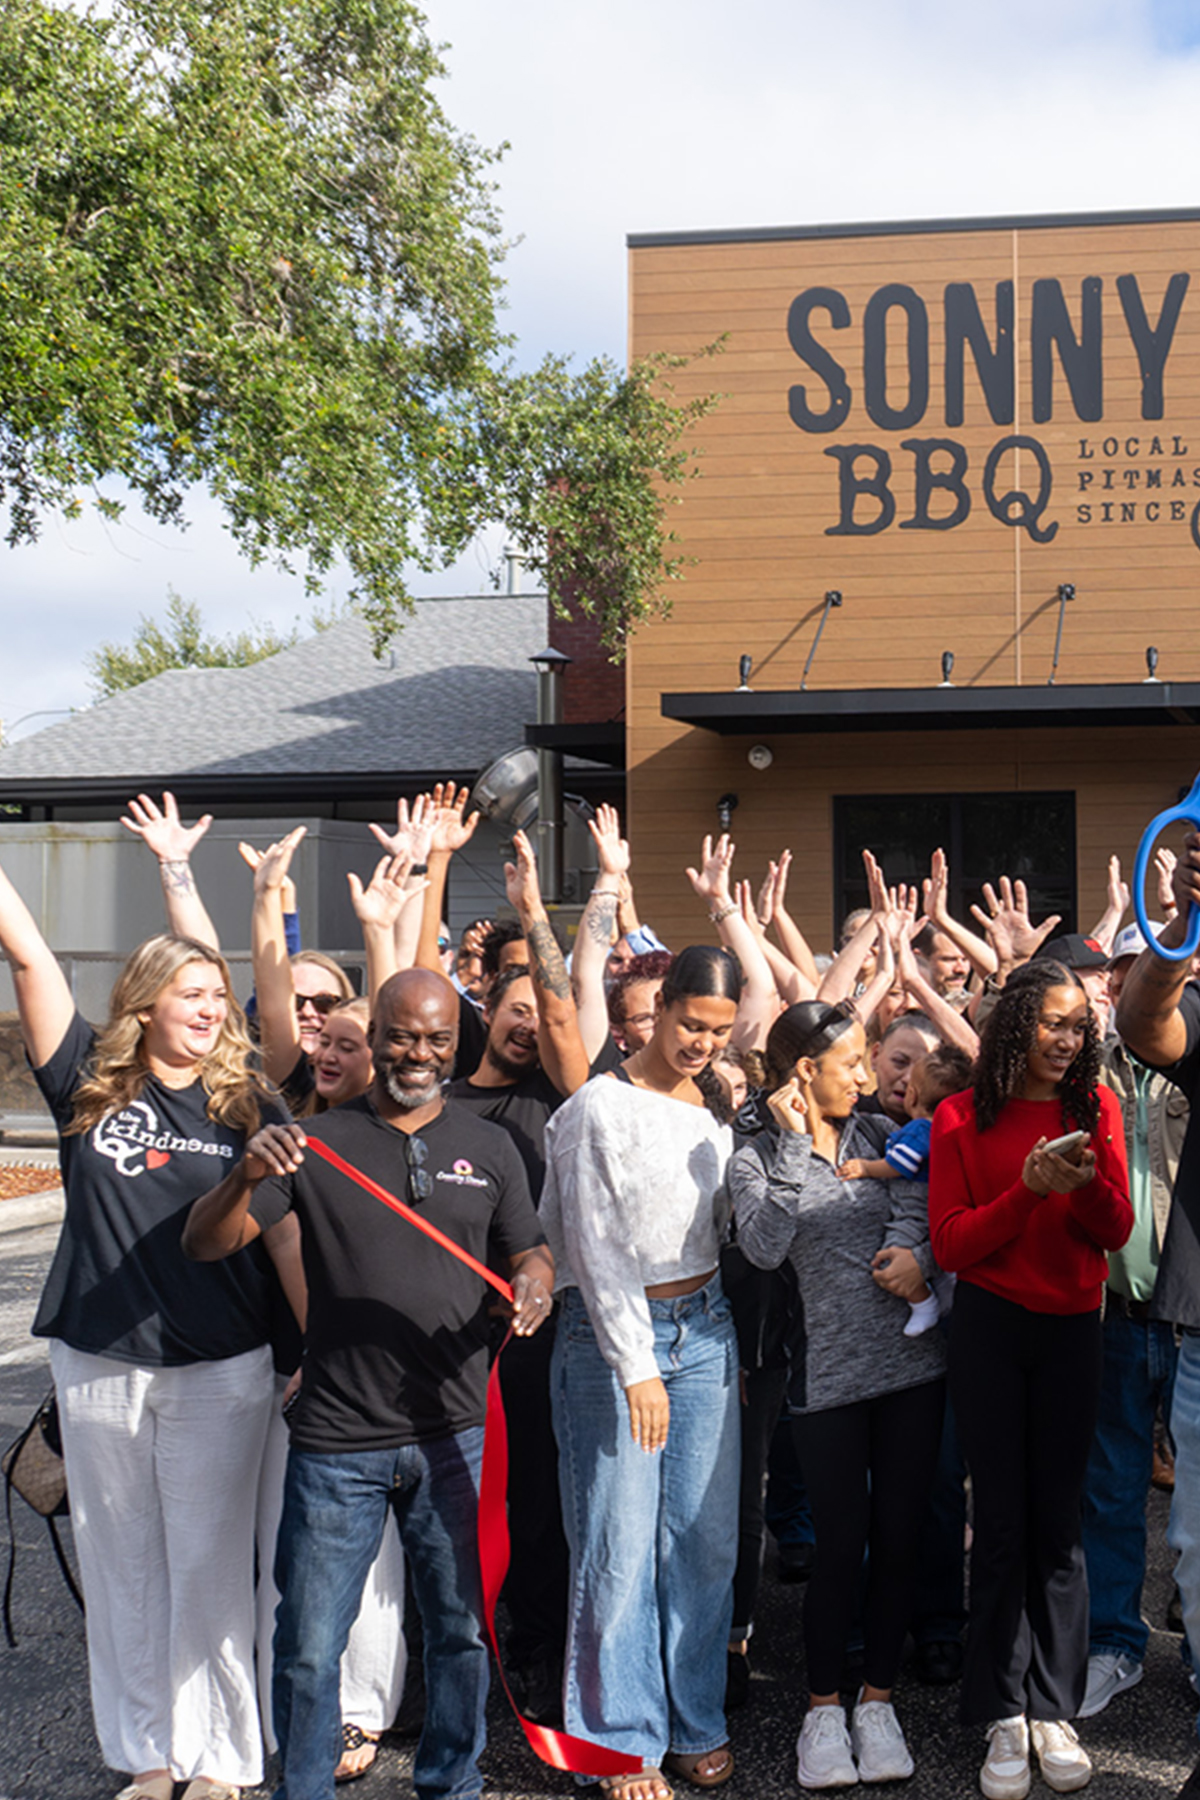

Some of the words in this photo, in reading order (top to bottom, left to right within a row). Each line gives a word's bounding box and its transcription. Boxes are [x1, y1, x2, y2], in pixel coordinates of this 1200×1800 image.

[1078, 436, 1188, 459] LOCAL
[824, 434, 1059, 543] BBQ
[1077, 500, 1186, 524] SINCE
[105, 1118, 234, 1159] kindness
